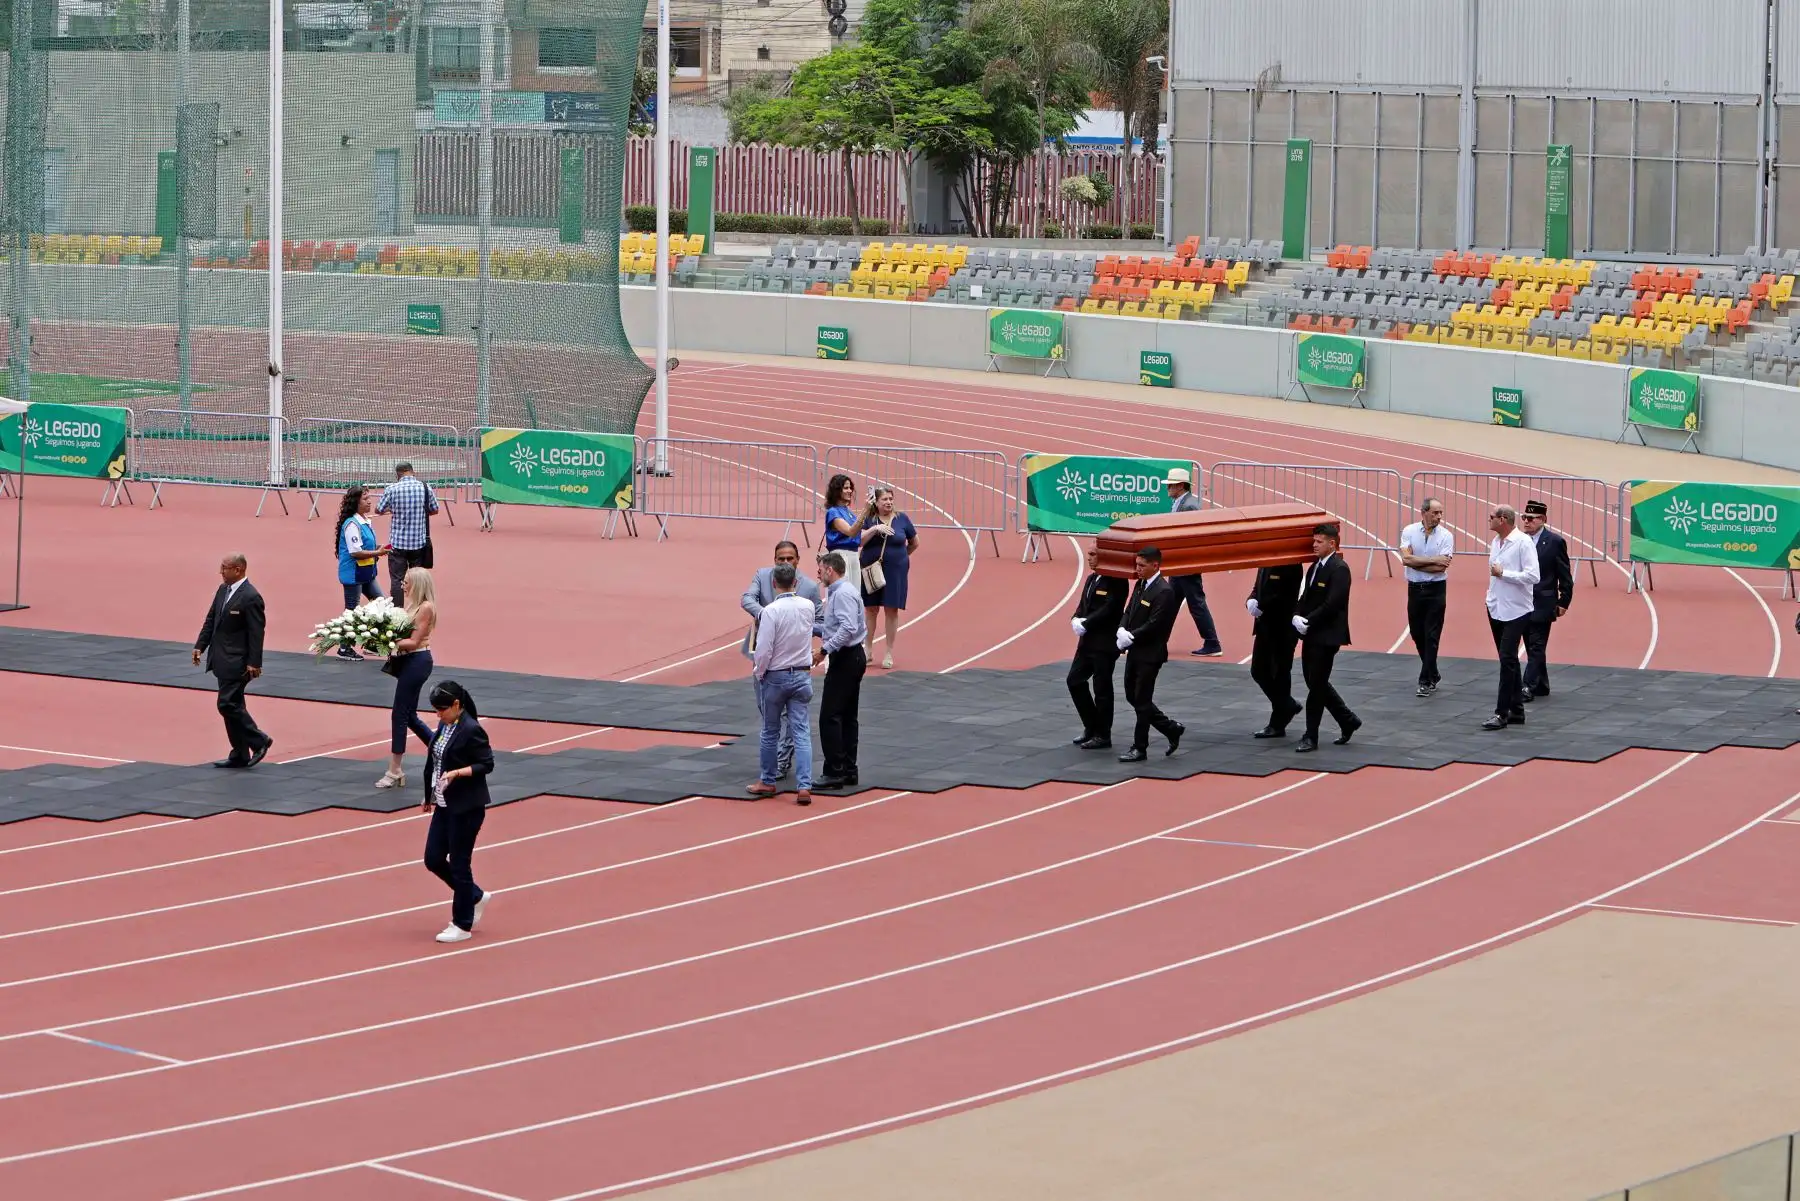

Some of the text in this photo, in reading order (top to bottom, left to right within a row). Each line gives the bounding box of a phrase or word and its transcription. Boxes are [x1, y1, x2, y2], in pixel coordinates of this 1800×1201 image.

[45, 437, 101, 450] Seguimos jugando
[541, 466, 605, 478] Seguimos jugando
[1090, 492, 1161, 505] Seguimos jugando
[1701, 522, 1777, 535] Seguimos jugando
